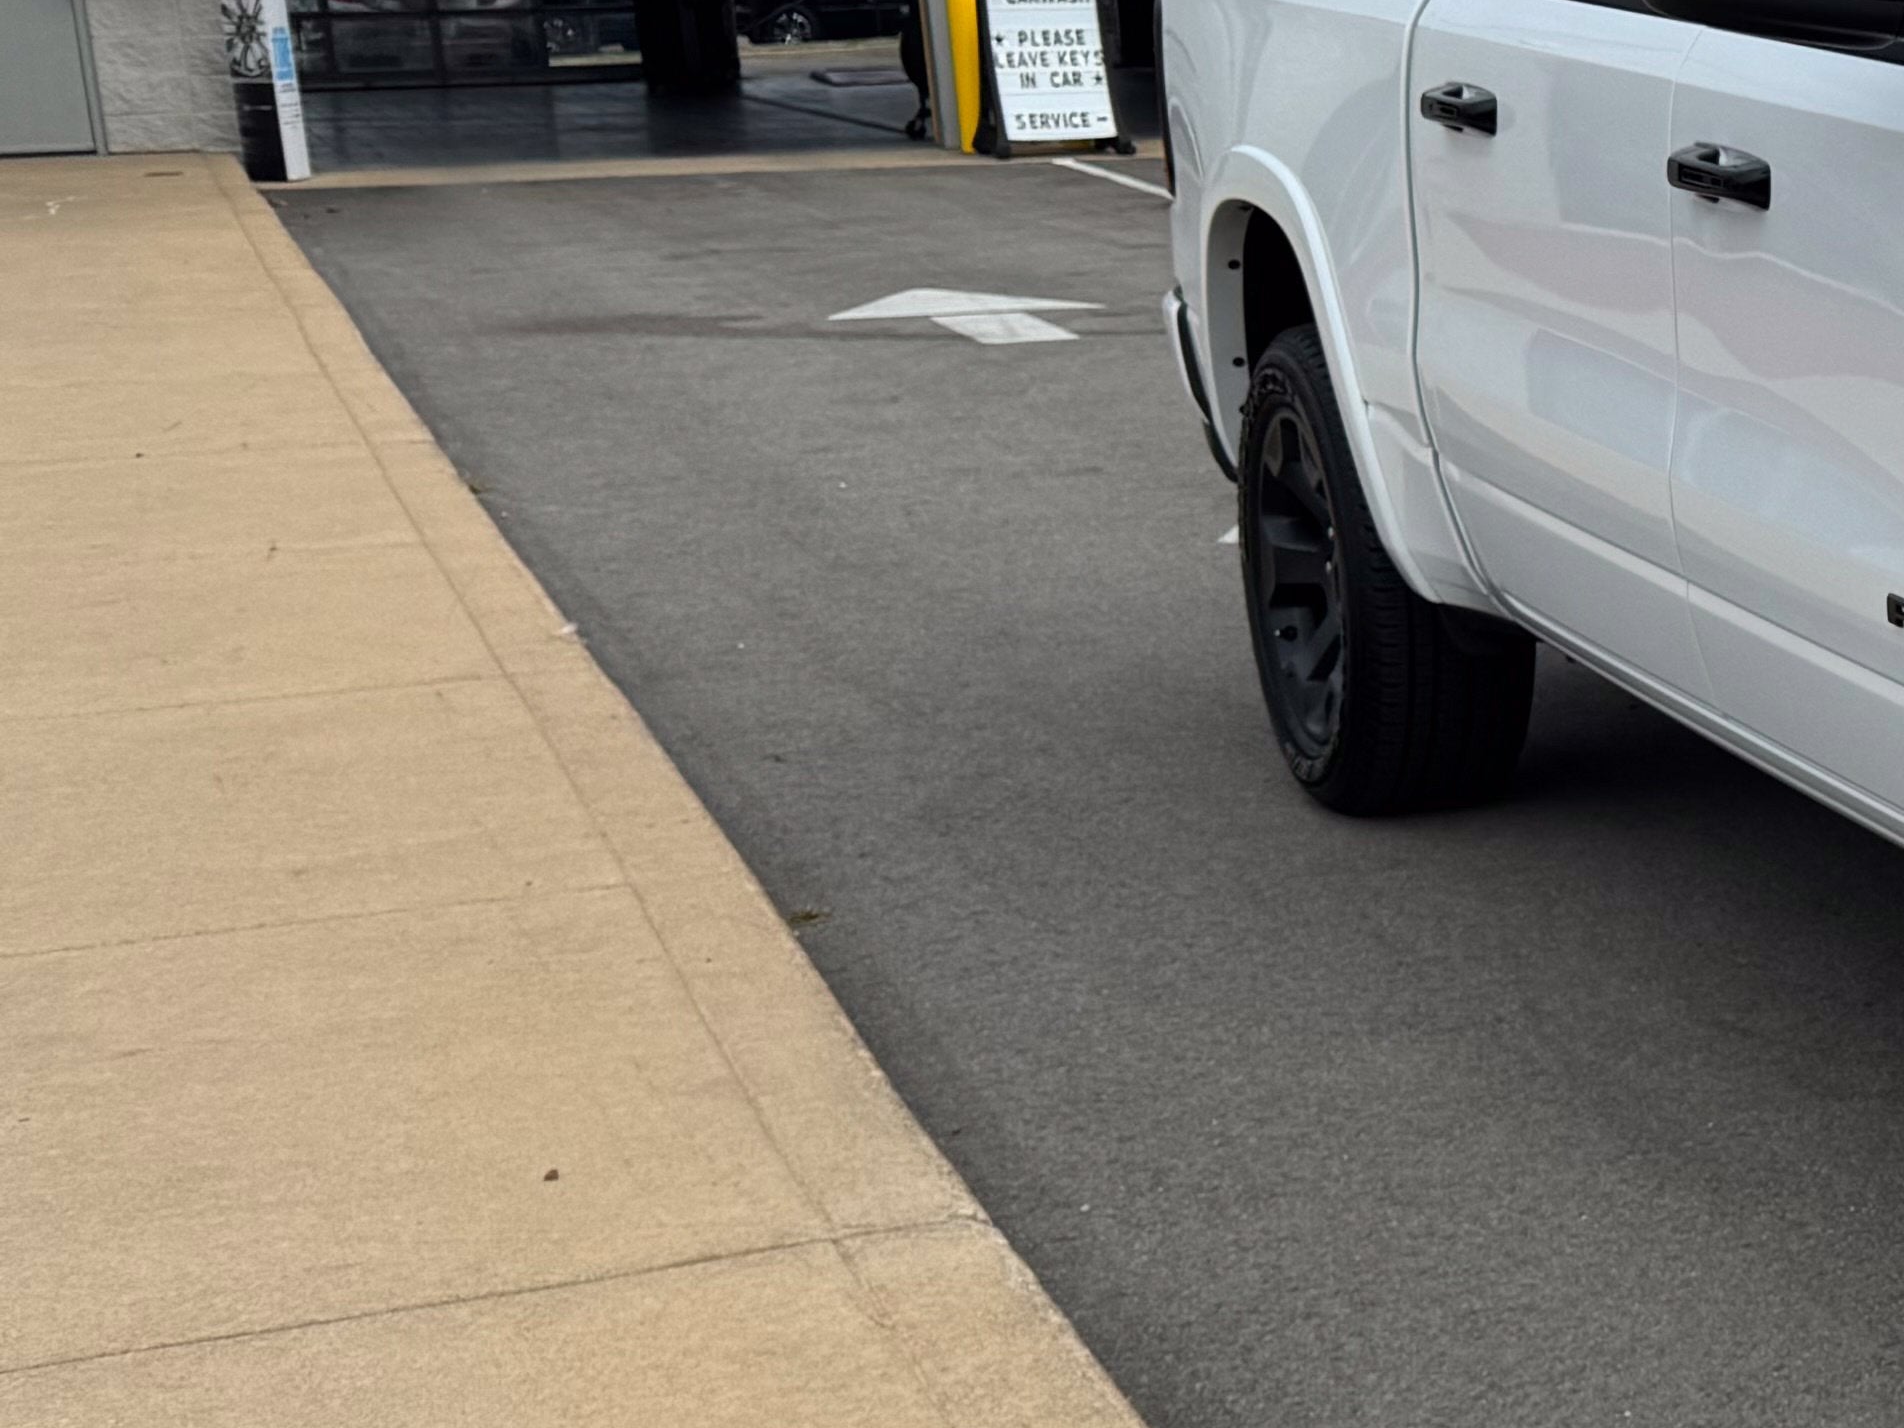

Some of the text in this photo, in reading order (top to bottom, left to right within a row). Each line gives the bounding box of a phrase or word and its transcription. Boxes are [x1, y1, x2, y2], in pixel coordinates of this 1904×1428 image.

[1018, 29, 1085, 47] PLEASE
[995, 49, 1105, 69] LEAVE KEYS
[1020, 72, 1084, 89] IN CAR
[1015, 113, 1091, 130] SERVICE
